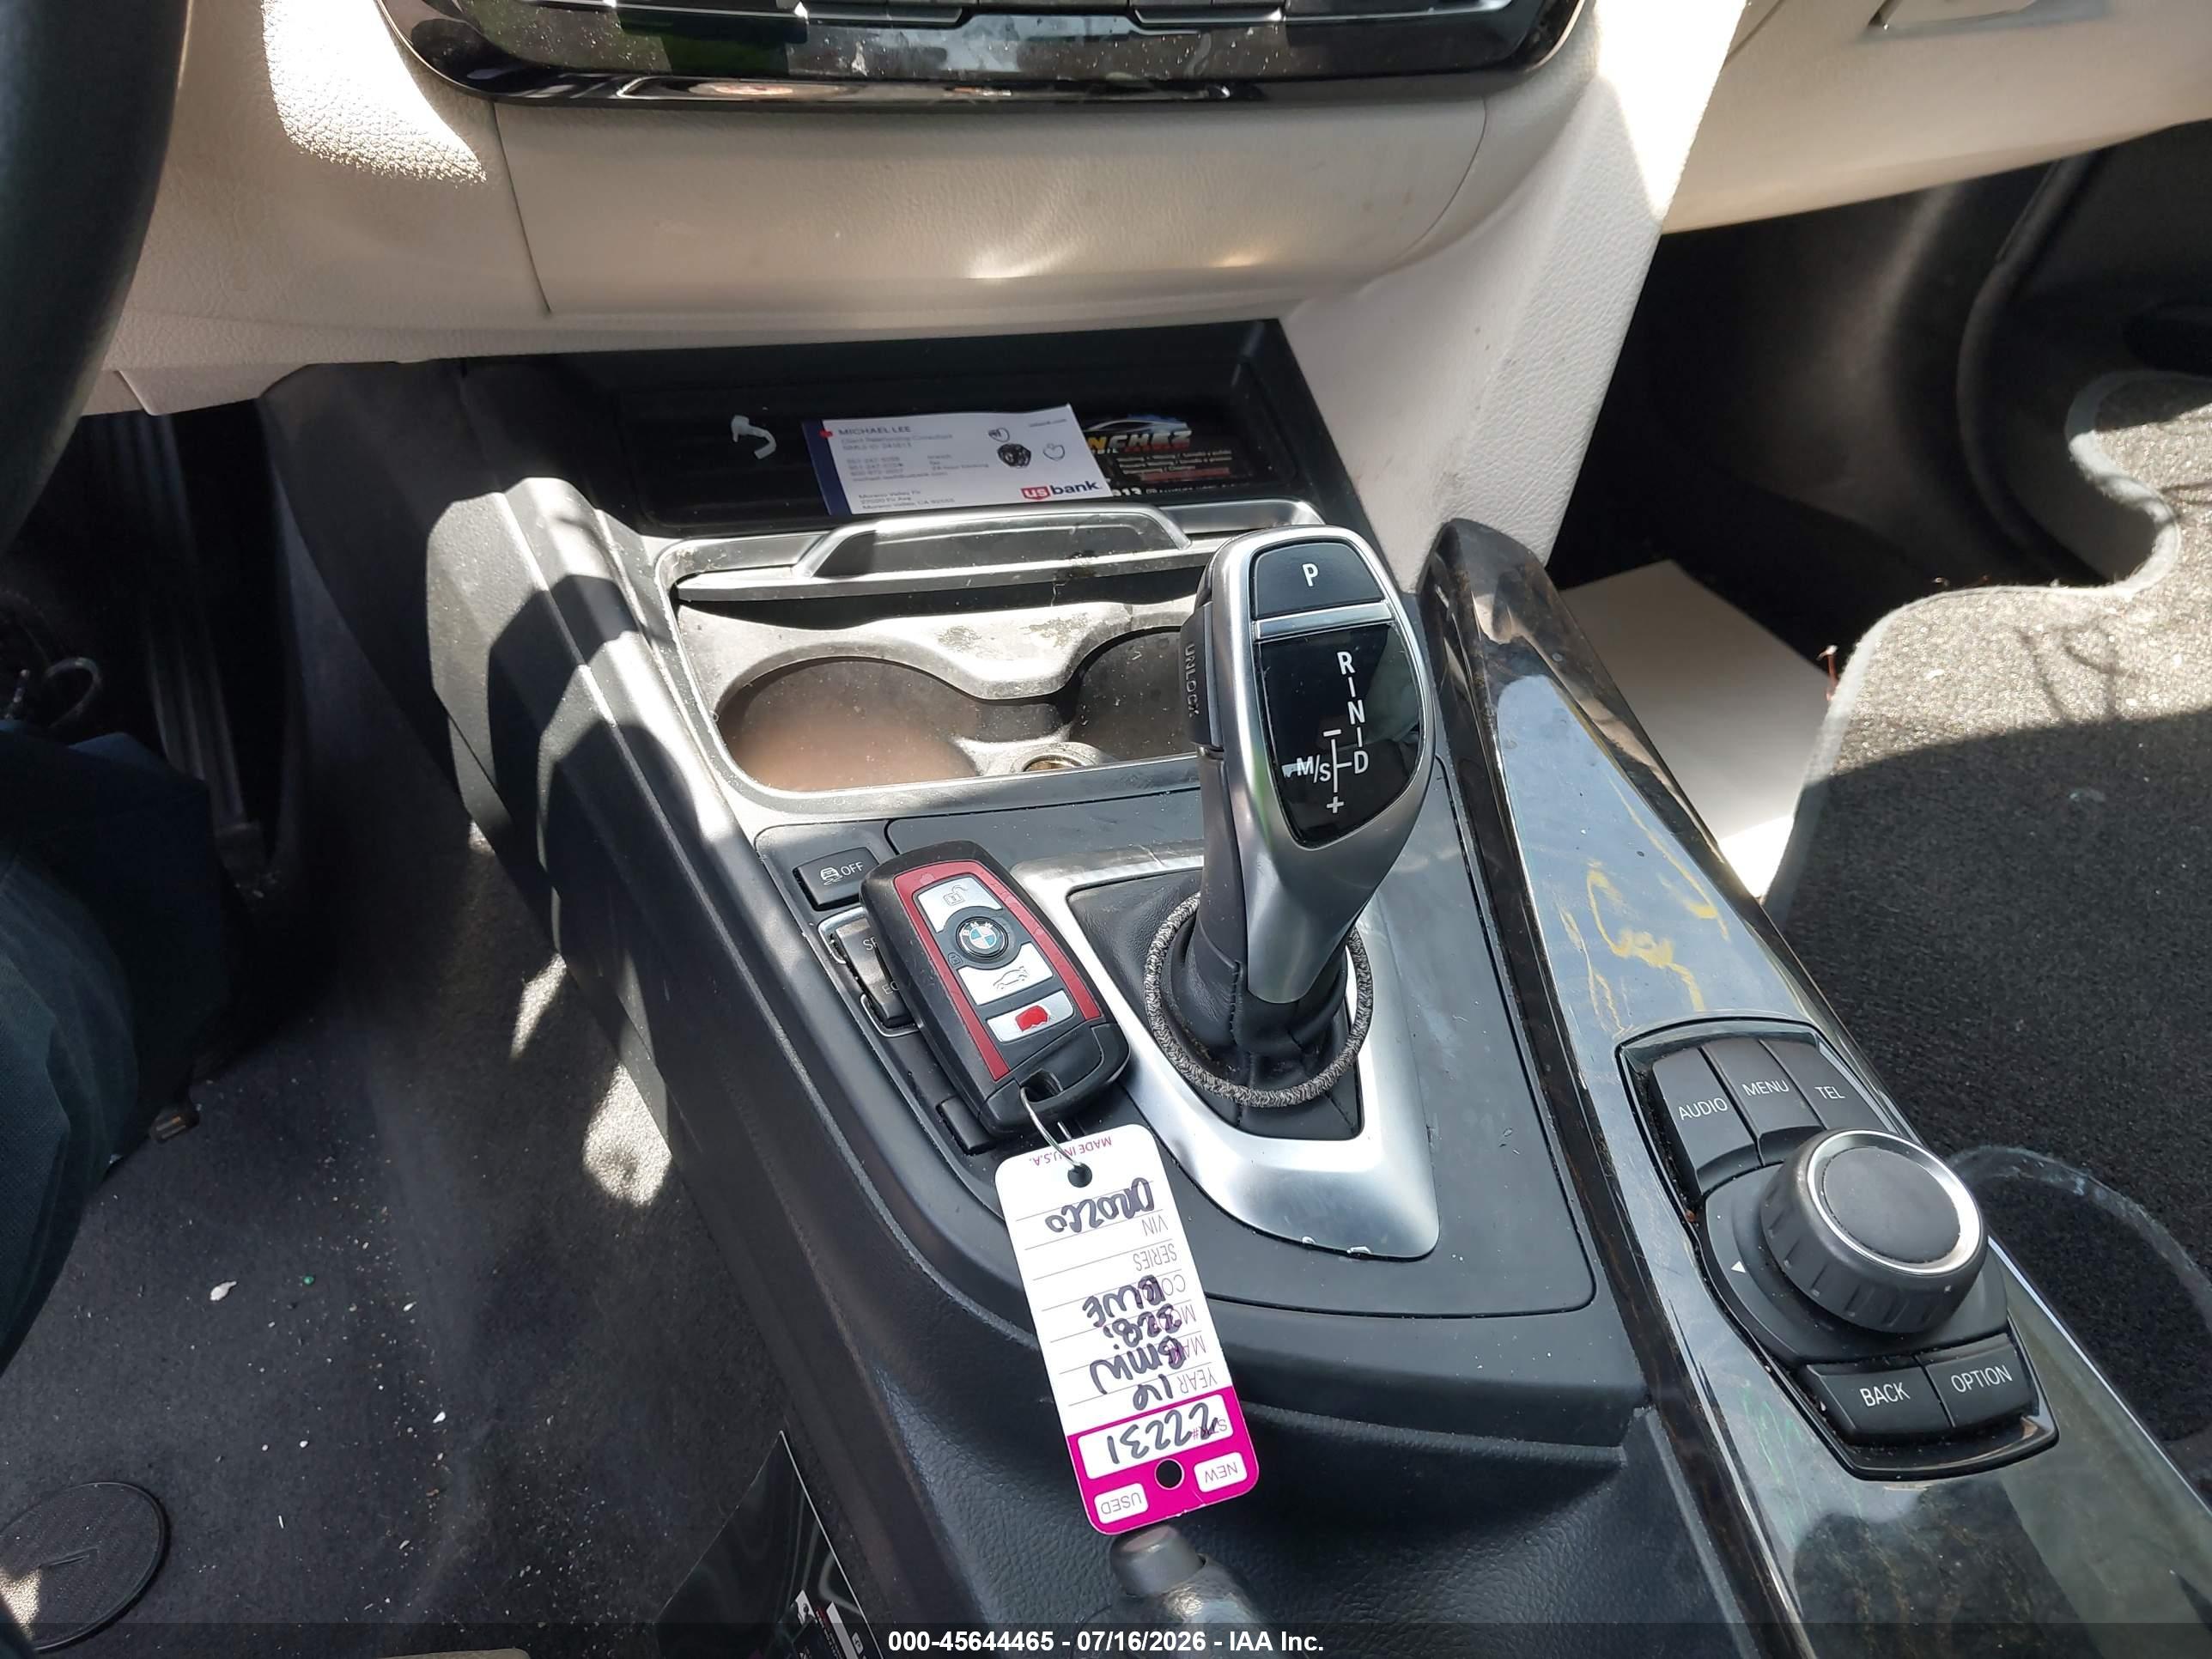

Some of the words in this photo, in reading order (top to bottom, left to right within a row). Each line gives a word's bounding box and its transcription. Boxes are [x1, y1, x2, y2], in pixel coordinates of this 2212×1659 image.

[838, 427, 890, 435] MICHAEL
[1302, 563, 1319, 587] P
[1337, 651, 1355, 675] R
[1184, 643, 1200, 718] UNLOCK
[1347, 700, 1366, 725] N
[1353, 750, 1369, 775] D
[840, 861, 864, 876] OFF
[962, 921, 993, 937] BMW
[1741, 1079, 1790, 1097] MENU
[1814, 1085, 1845, 1100] TEL
[1677, 1097, 1729, 1121] AUDIO
[1079, 1136, 1113, 1154] MADE
[1142, 1214, 1169, 1237] VIN
[1133, 1243, 1178, 1272] SERIES
[1176, 1367, 1218, 1394] YEAR
[1949, 1364, 2013, 1393] OPTION
[1133, 1374, 1174, 1411] 16
[1859, 1381, 1911, 1407] BACK
[1107, 1402, 1218, 1465] 22231
[1204, 1462, 1238, 1484] NEW
[1101, 1492, 1142, 1515] USED
